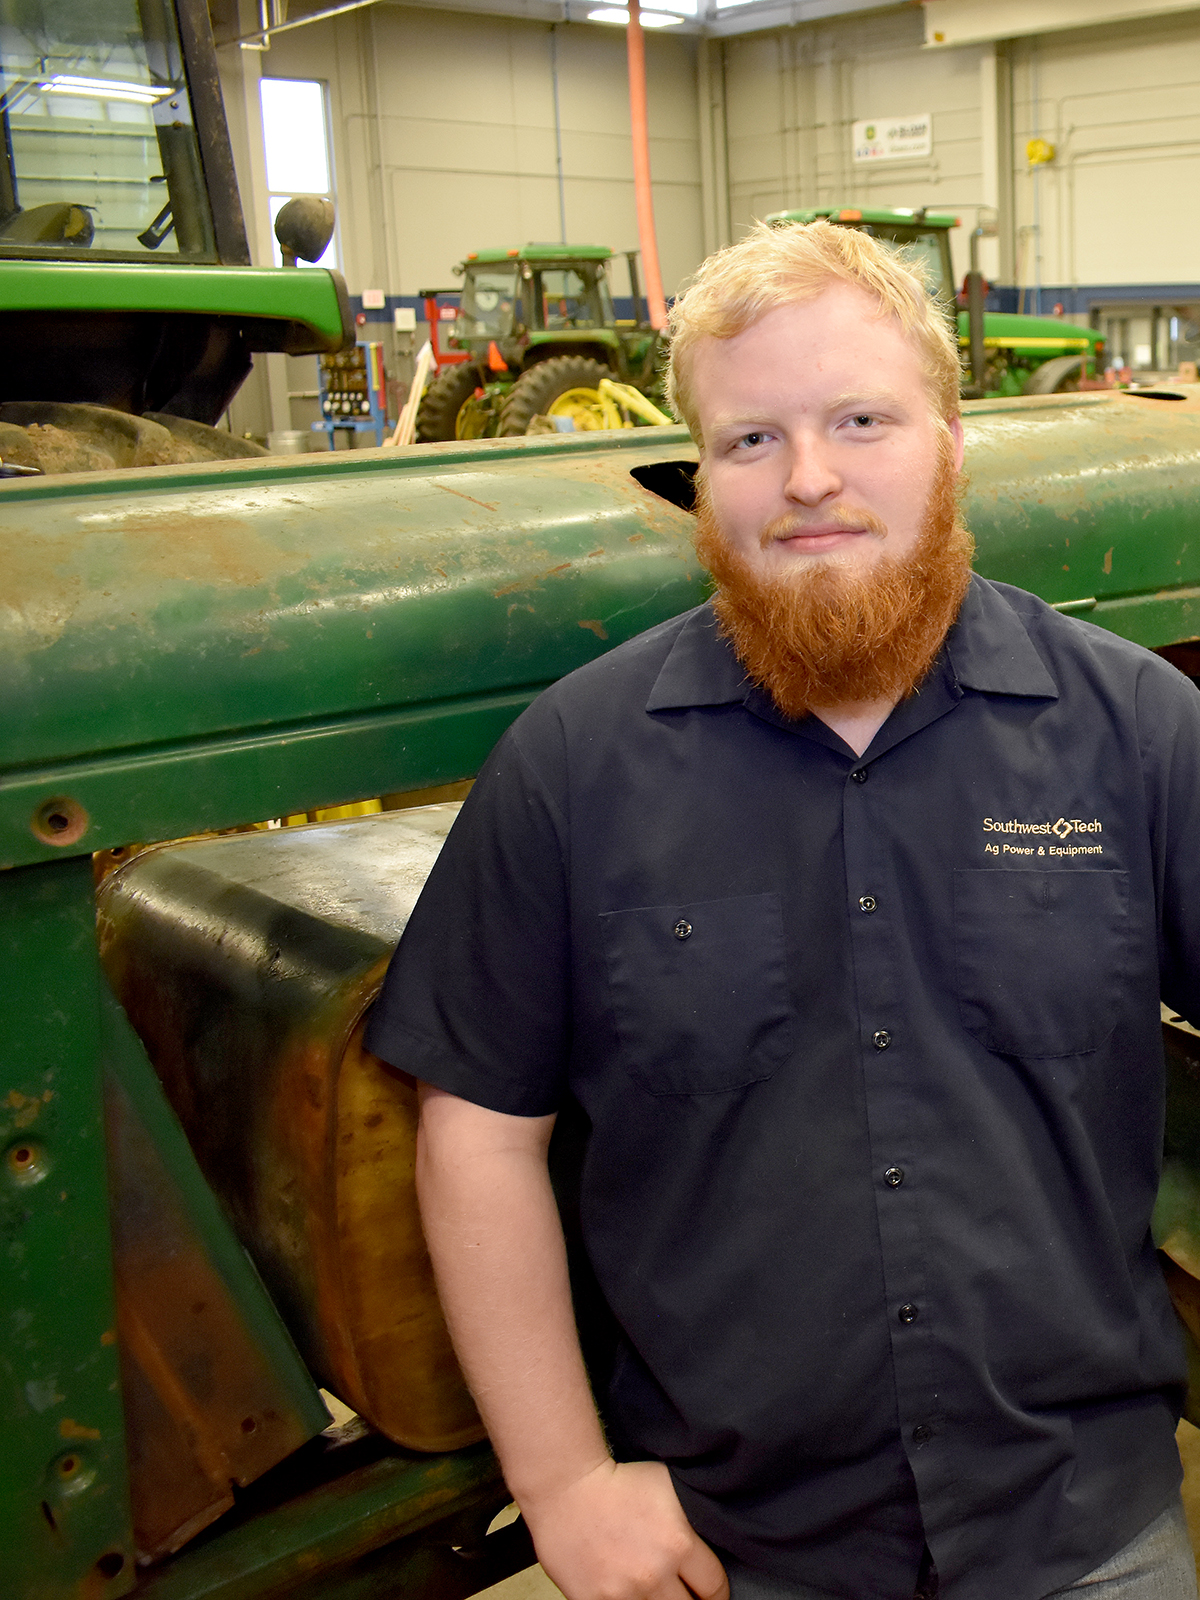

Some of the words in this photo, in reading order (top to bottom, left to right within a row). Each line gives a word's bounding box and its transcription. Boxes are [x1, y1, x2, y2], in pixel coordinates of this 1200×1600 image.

[983, 818, 1052, 835] Southwest
[1070, 819, 1102, 833] Tech
[984, 843, 1000, 856] Ag
[1002, 844, 1034, 855] Power
[1037, 846, 1046, 856] &
[1049, 845, 1103, 857] Equipment
